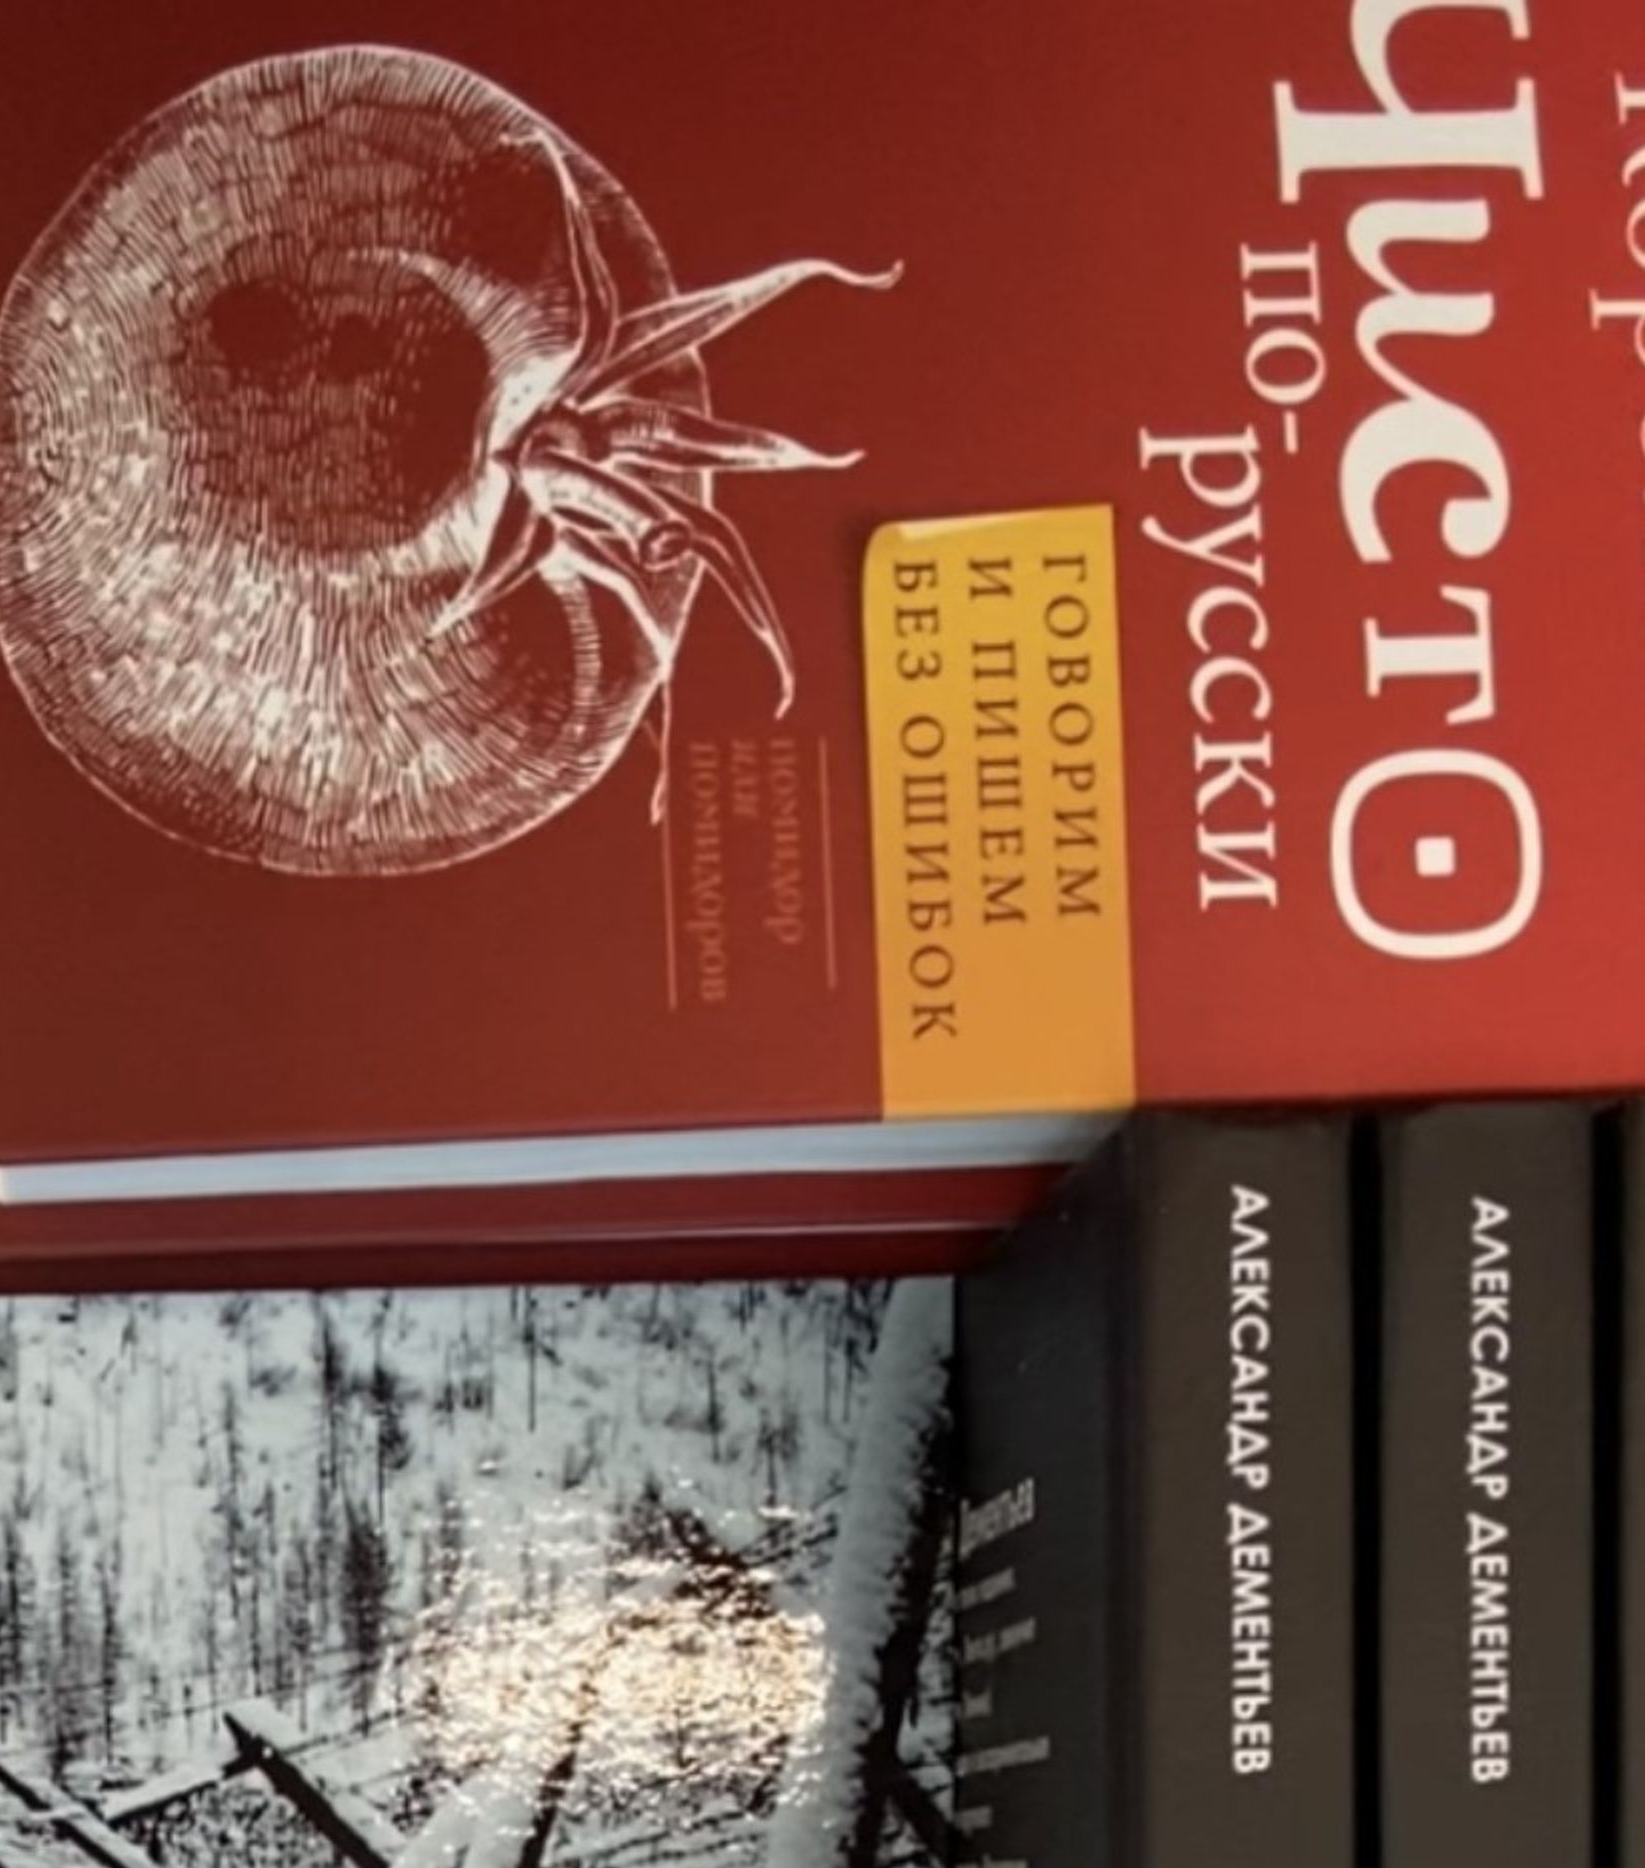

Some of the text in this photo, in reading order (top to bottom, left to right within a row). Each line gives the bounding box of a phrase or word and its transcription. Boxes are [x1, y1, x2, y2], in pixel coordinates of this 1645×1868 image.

[1239, 241, 1326, 454] по-
[1274, 0, 1545, 960] Чисто
[893, 557, 959, 1042] БЕЗ ОШИБОК
[968, 554, 1028, 927] И ПИШЕМ
[1043, 552, 1101, 920] ГОВОРИМ
[1139, 425, 1280, 912] русски
[1226, 1184, 1273, 1774] АЛЕКСАНДР ДЕМЕНТЬЕВ
[1466, 1197, 1511, 1784] АЛЕКСАНДР ДЕМЕНТЬЕВ
